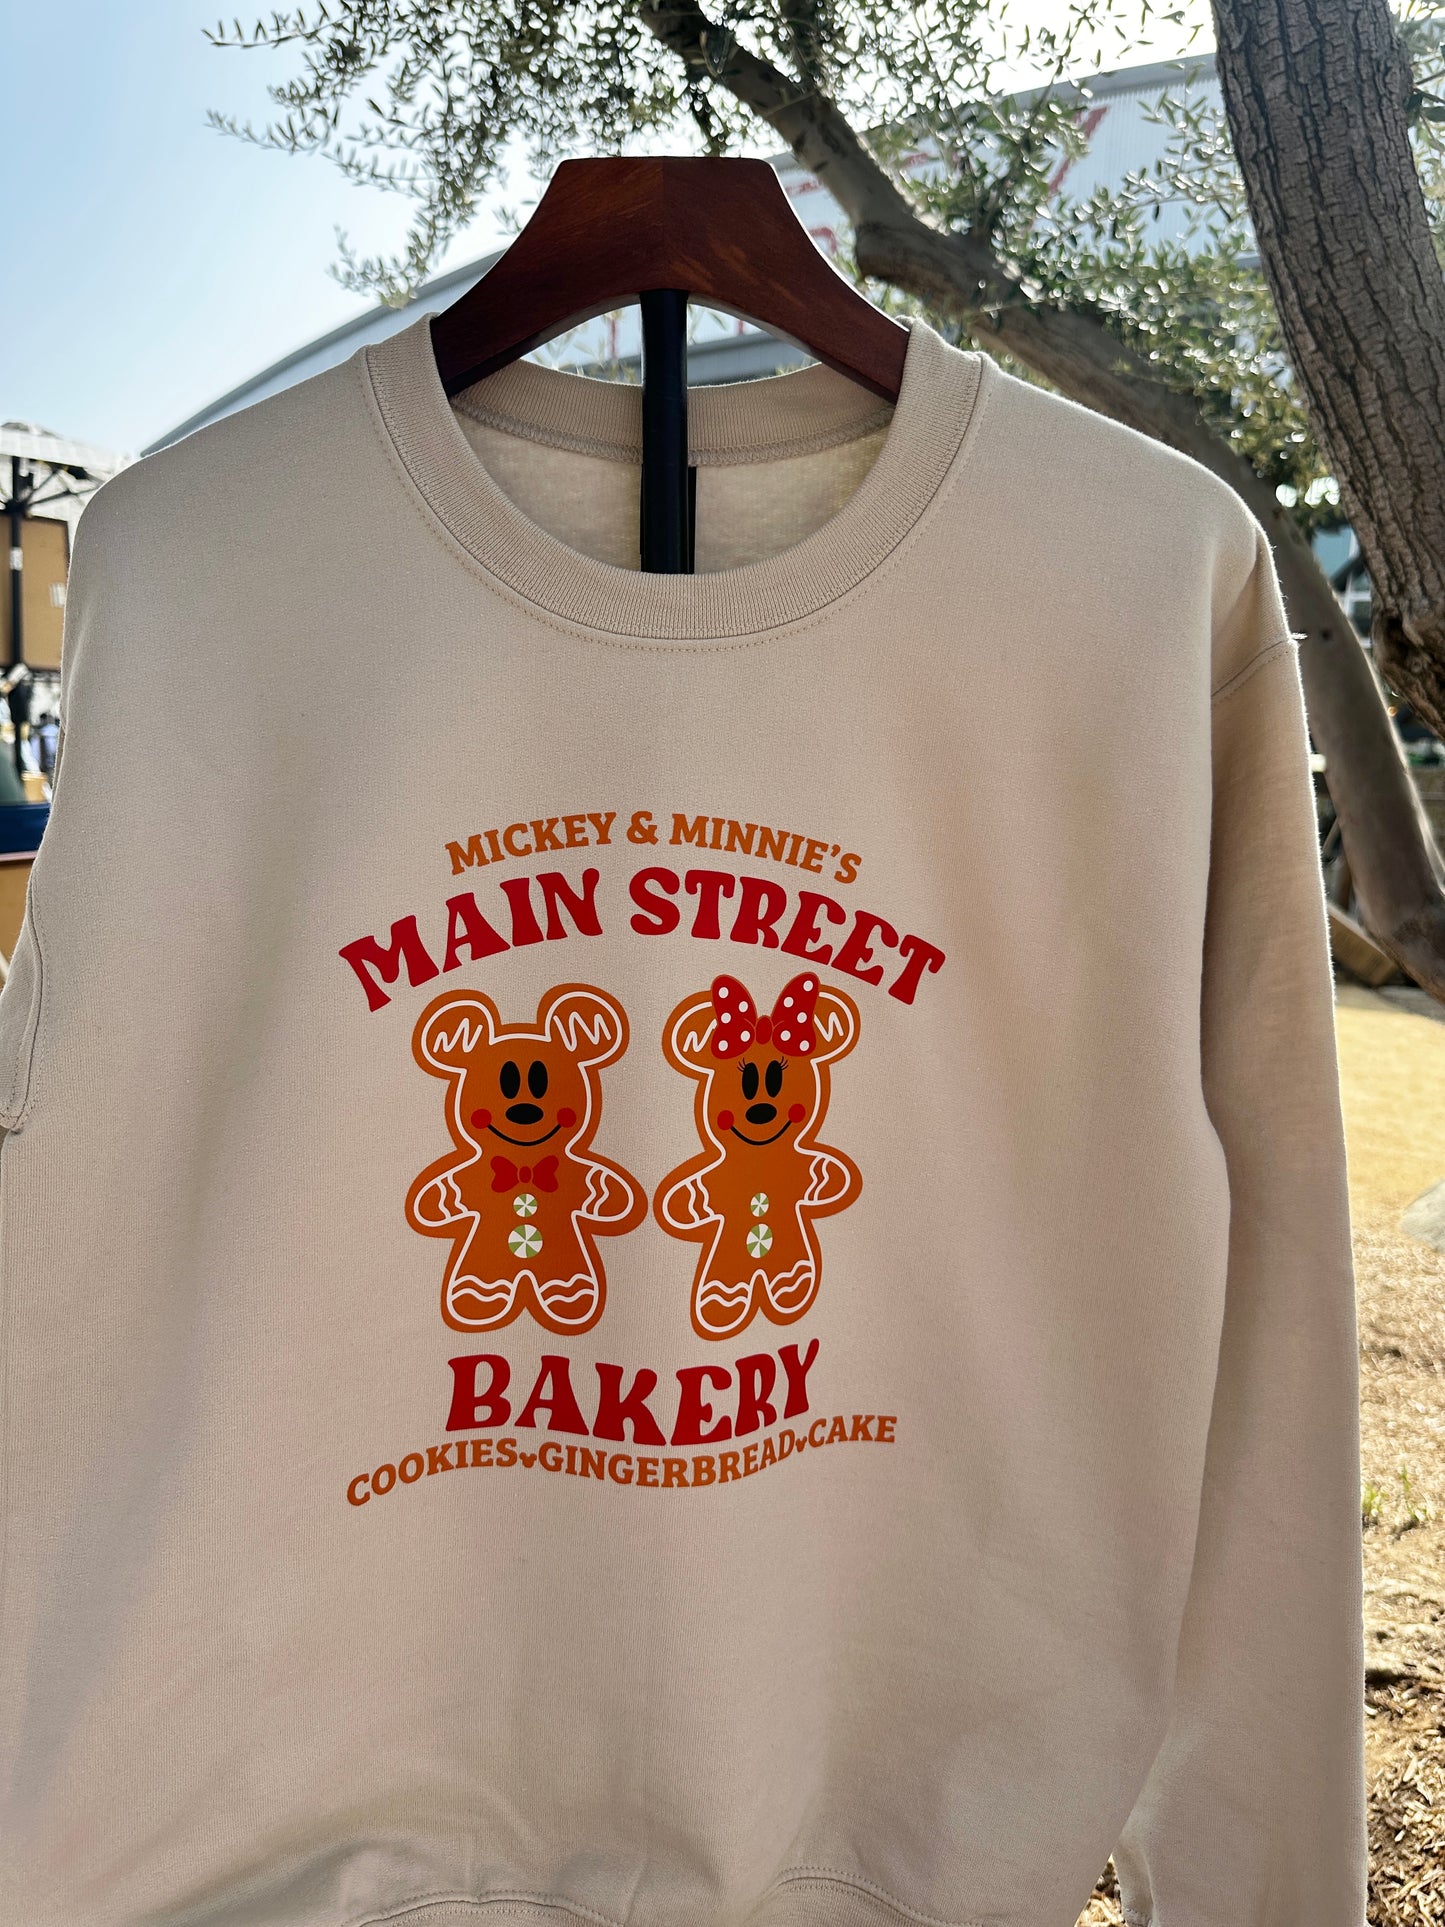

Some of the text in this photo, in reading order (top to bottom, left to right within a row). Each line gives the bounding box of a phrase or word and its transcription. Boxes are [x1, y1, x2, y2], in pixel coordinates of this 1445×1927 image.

[445, 810, 862, 884] MICKEY & MINNIE’S
[338, 866, 946, 1012] MAIN STREET
[445, 1338, 820, 1446] BAKERY
[346, 1414, 898, 1506] COOKIES GINGERBREAD CAKE
